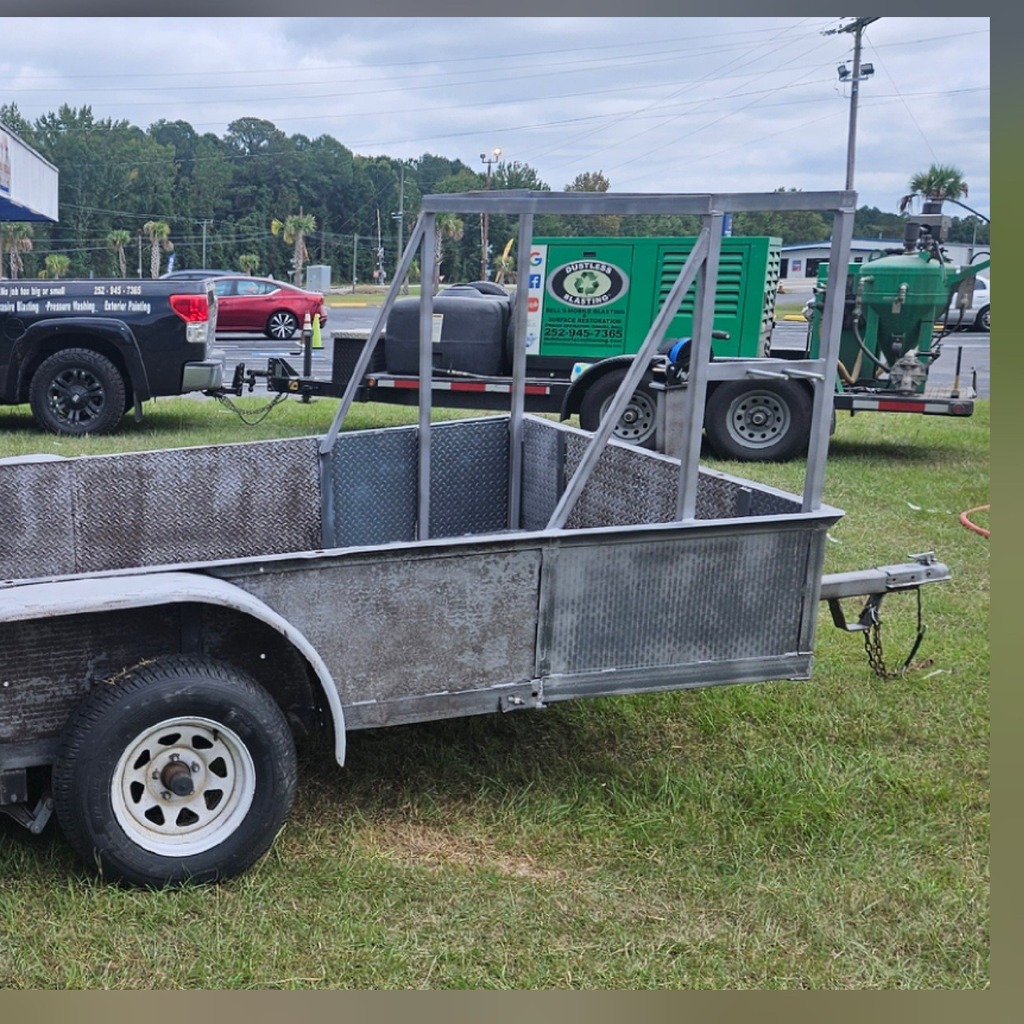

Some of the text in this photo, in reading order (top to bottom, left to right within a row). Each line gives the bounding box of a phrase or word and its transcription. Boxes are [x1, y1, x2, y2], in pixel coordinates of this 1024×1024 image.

[565, 262, 612, 274] DUSTLESS
[0, 287, 8, 296] No
[10, 287, 18, 297] job
[20, 287, 29, 295] too
[31, 286, 41, 297] big
[50, 286, 65, 295] small
[94, 286, 105, 295] 252
[110, 286, 121, 295] 945
[126, 286, 142, 295] 7365
[563, 294, 609, 305] BLASTING
[17, 301, 39, 314] Blasting
[104, 300, 151, 314] Exterior Painting
[545, 328, 622, 338] 252-945-7365
